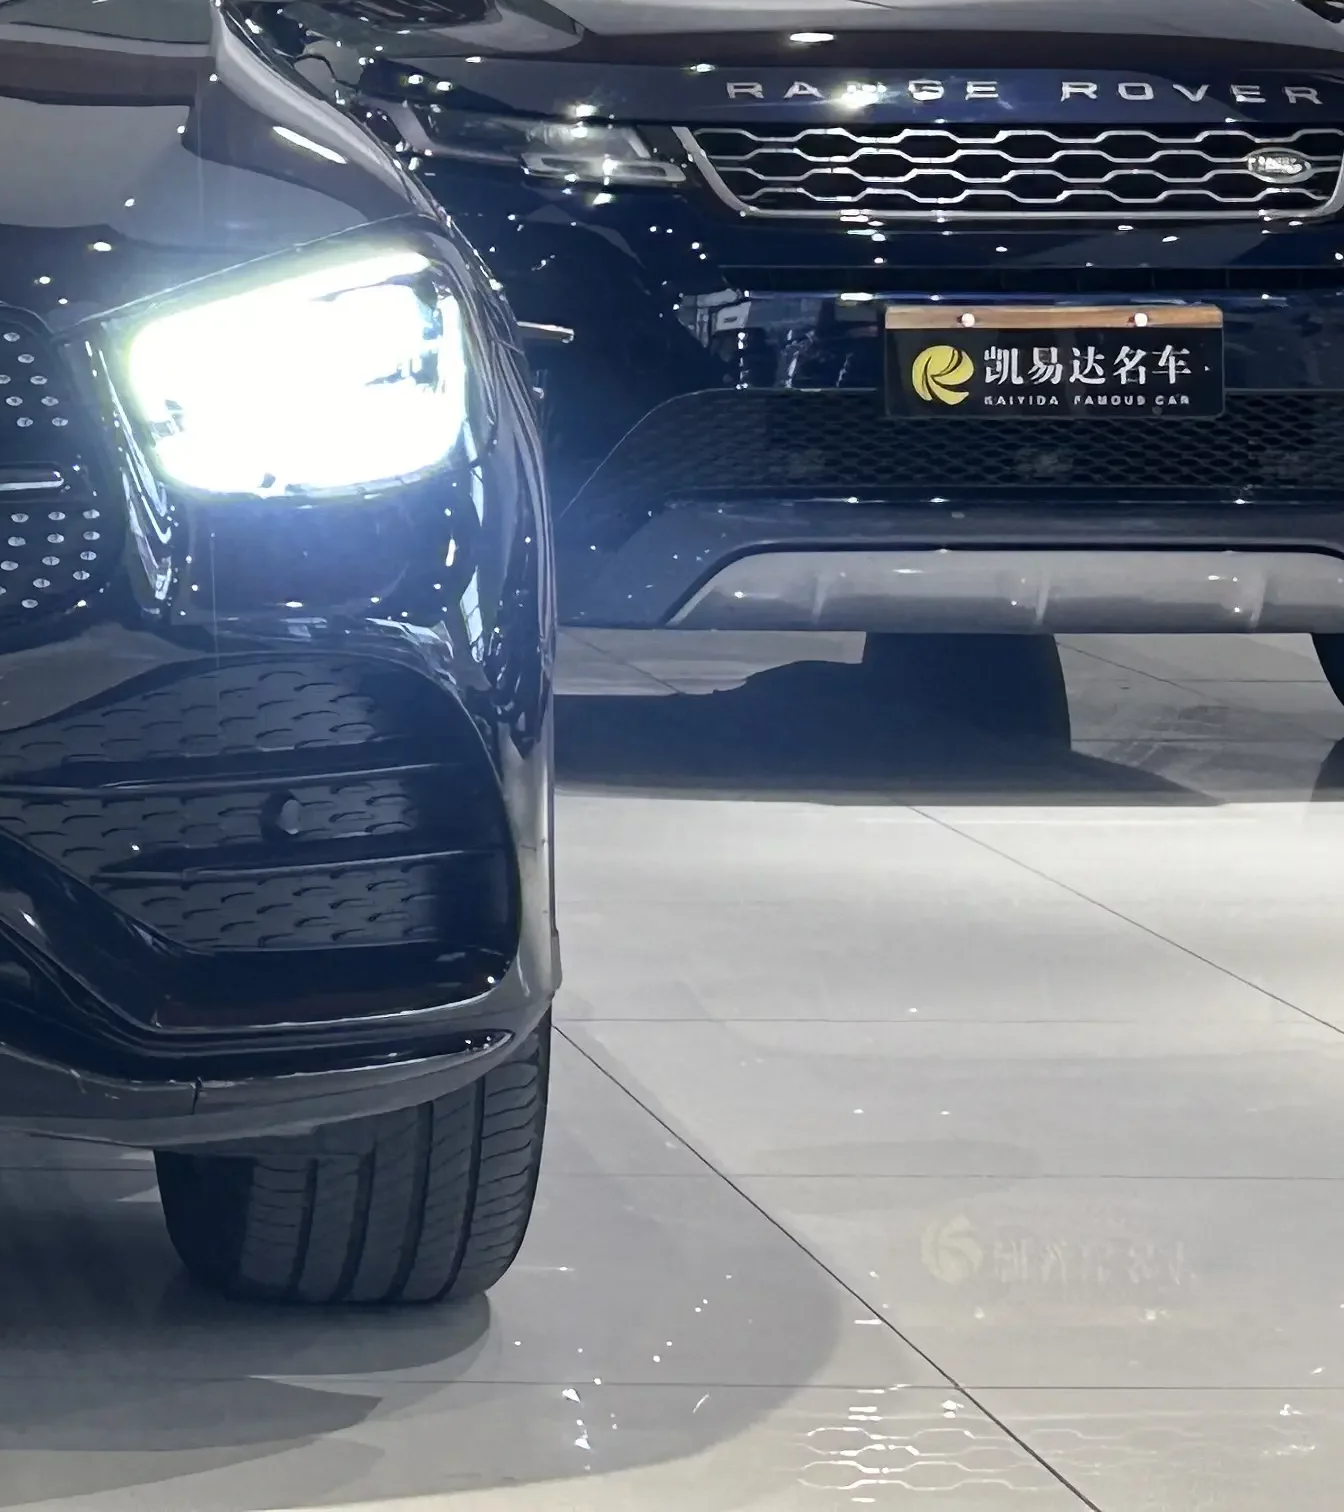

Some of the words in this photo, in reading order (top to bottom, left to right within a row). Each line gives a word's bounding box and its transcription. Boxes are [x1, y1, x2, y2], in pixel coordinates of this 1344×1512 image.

[1060, 81, 1323, 104] ROVER
[983, 344, 1192, 385] 凯易达名车
